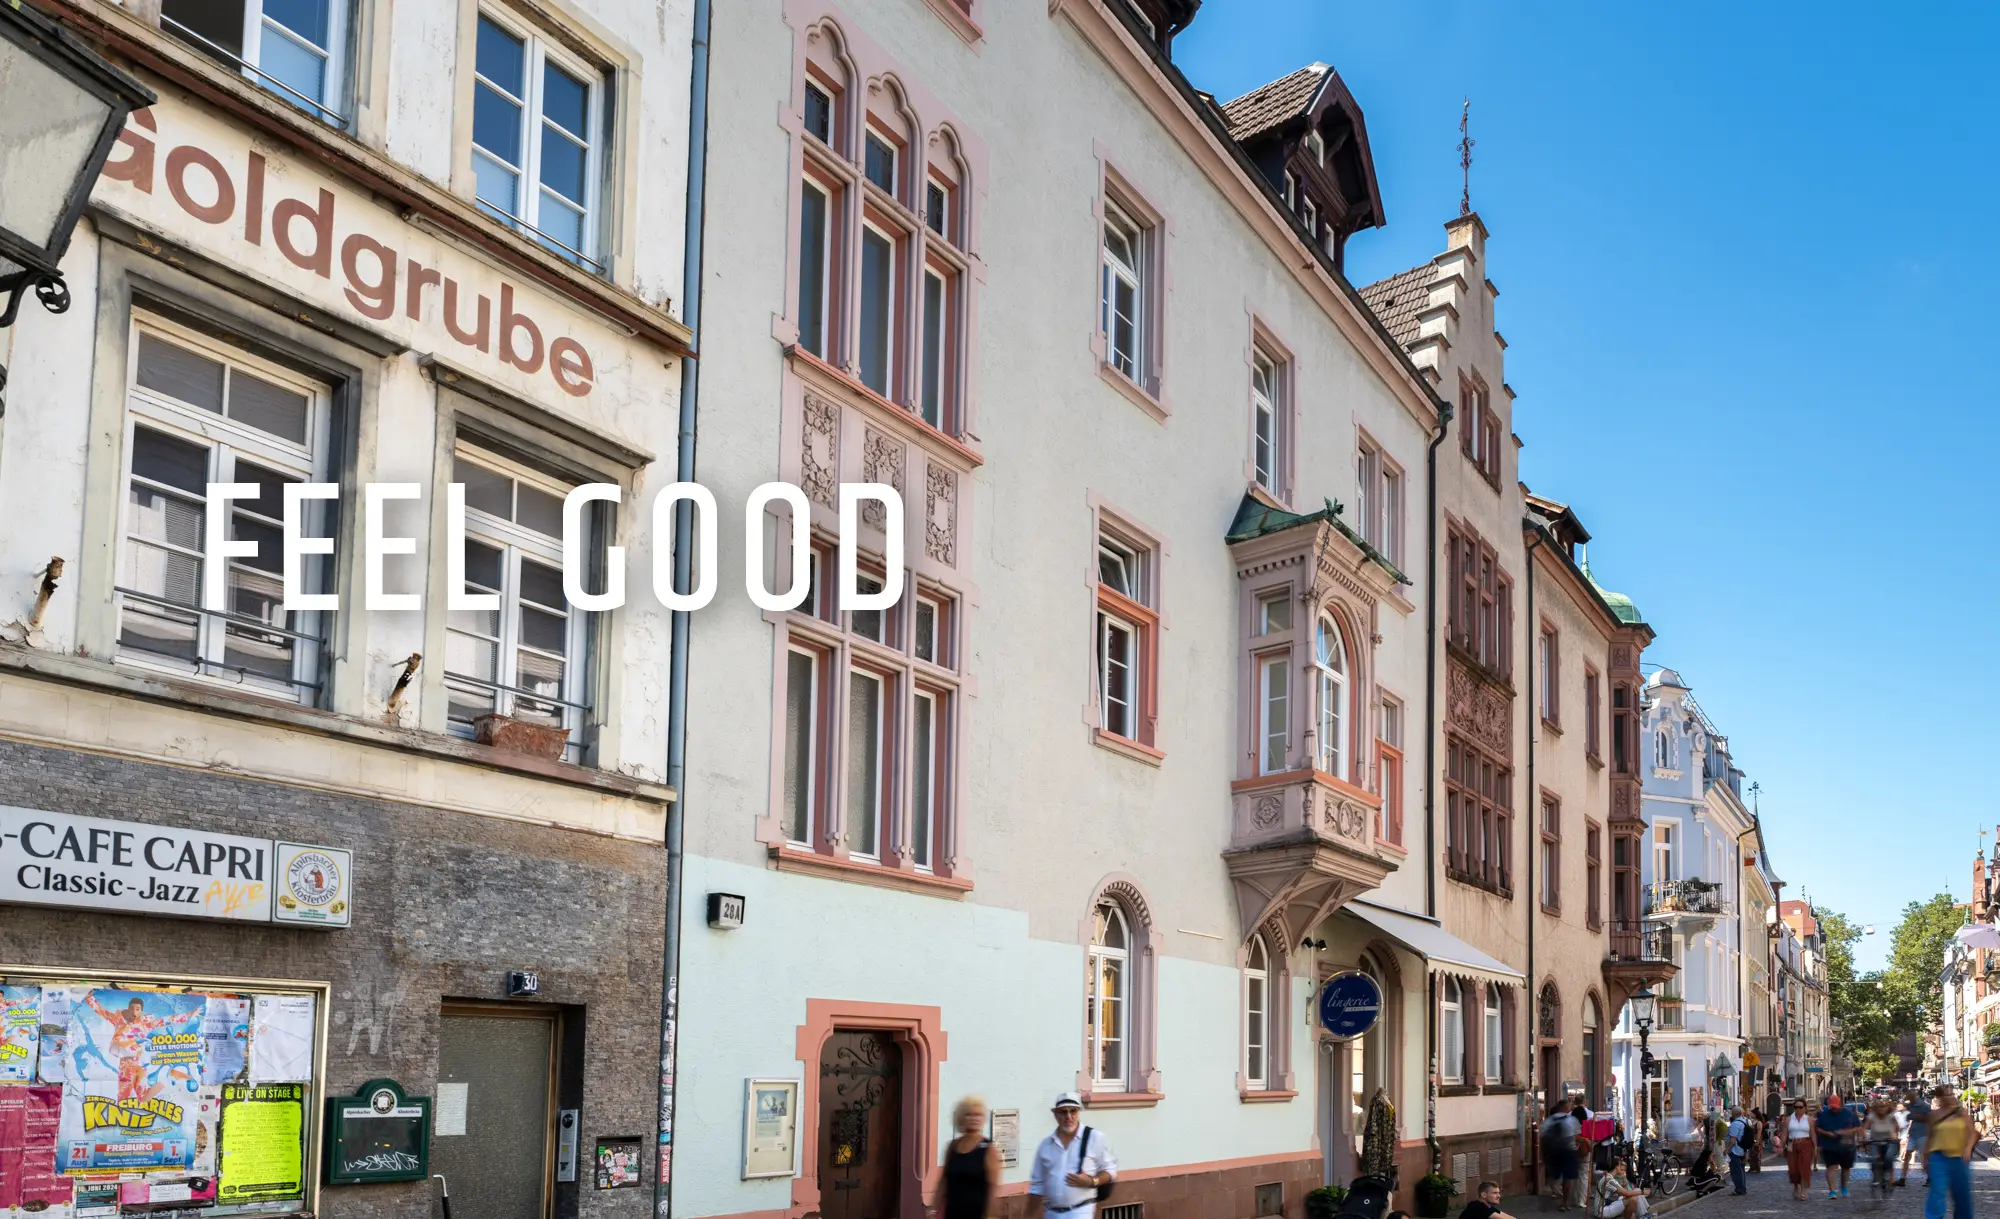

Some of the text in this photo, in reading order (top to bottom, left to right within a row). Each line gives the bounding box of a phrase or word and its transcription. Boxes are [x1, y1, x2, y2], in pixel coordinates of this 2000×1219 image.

[100, 106, 594, 398] Goldgrube
[0, 821, 265, 882] -CAFE CAPRI
[290, 853, 338, 881] Alpirsbacher
[291, 881, 338, 904] Klosterbräu
[723, 902, 740, 921] 28A
[523, 975, 538, 991] 30
[1327, 987, 1370, 1022] lingerie
[151, 1033, 198, 1045] 100.000
[85, 1096, 116, 1104] ZIRKUS
[236, 1088, 292, 1099] LIVE ON STAGE
[83, 1102, 156, 1132] KNIE
[118, 1097, 184, 1123] CHARLES
[71, 1147, 90, 1159] 21.
[106, 1143, 153, 1152] FREIBURG
[171, 1146, 179, 1156] 1.
[164, 1156, 184, 1165] Sept.
[87, 1184, 102, 1192] JUNI
[102, 1183, 118, 1191] 2024
